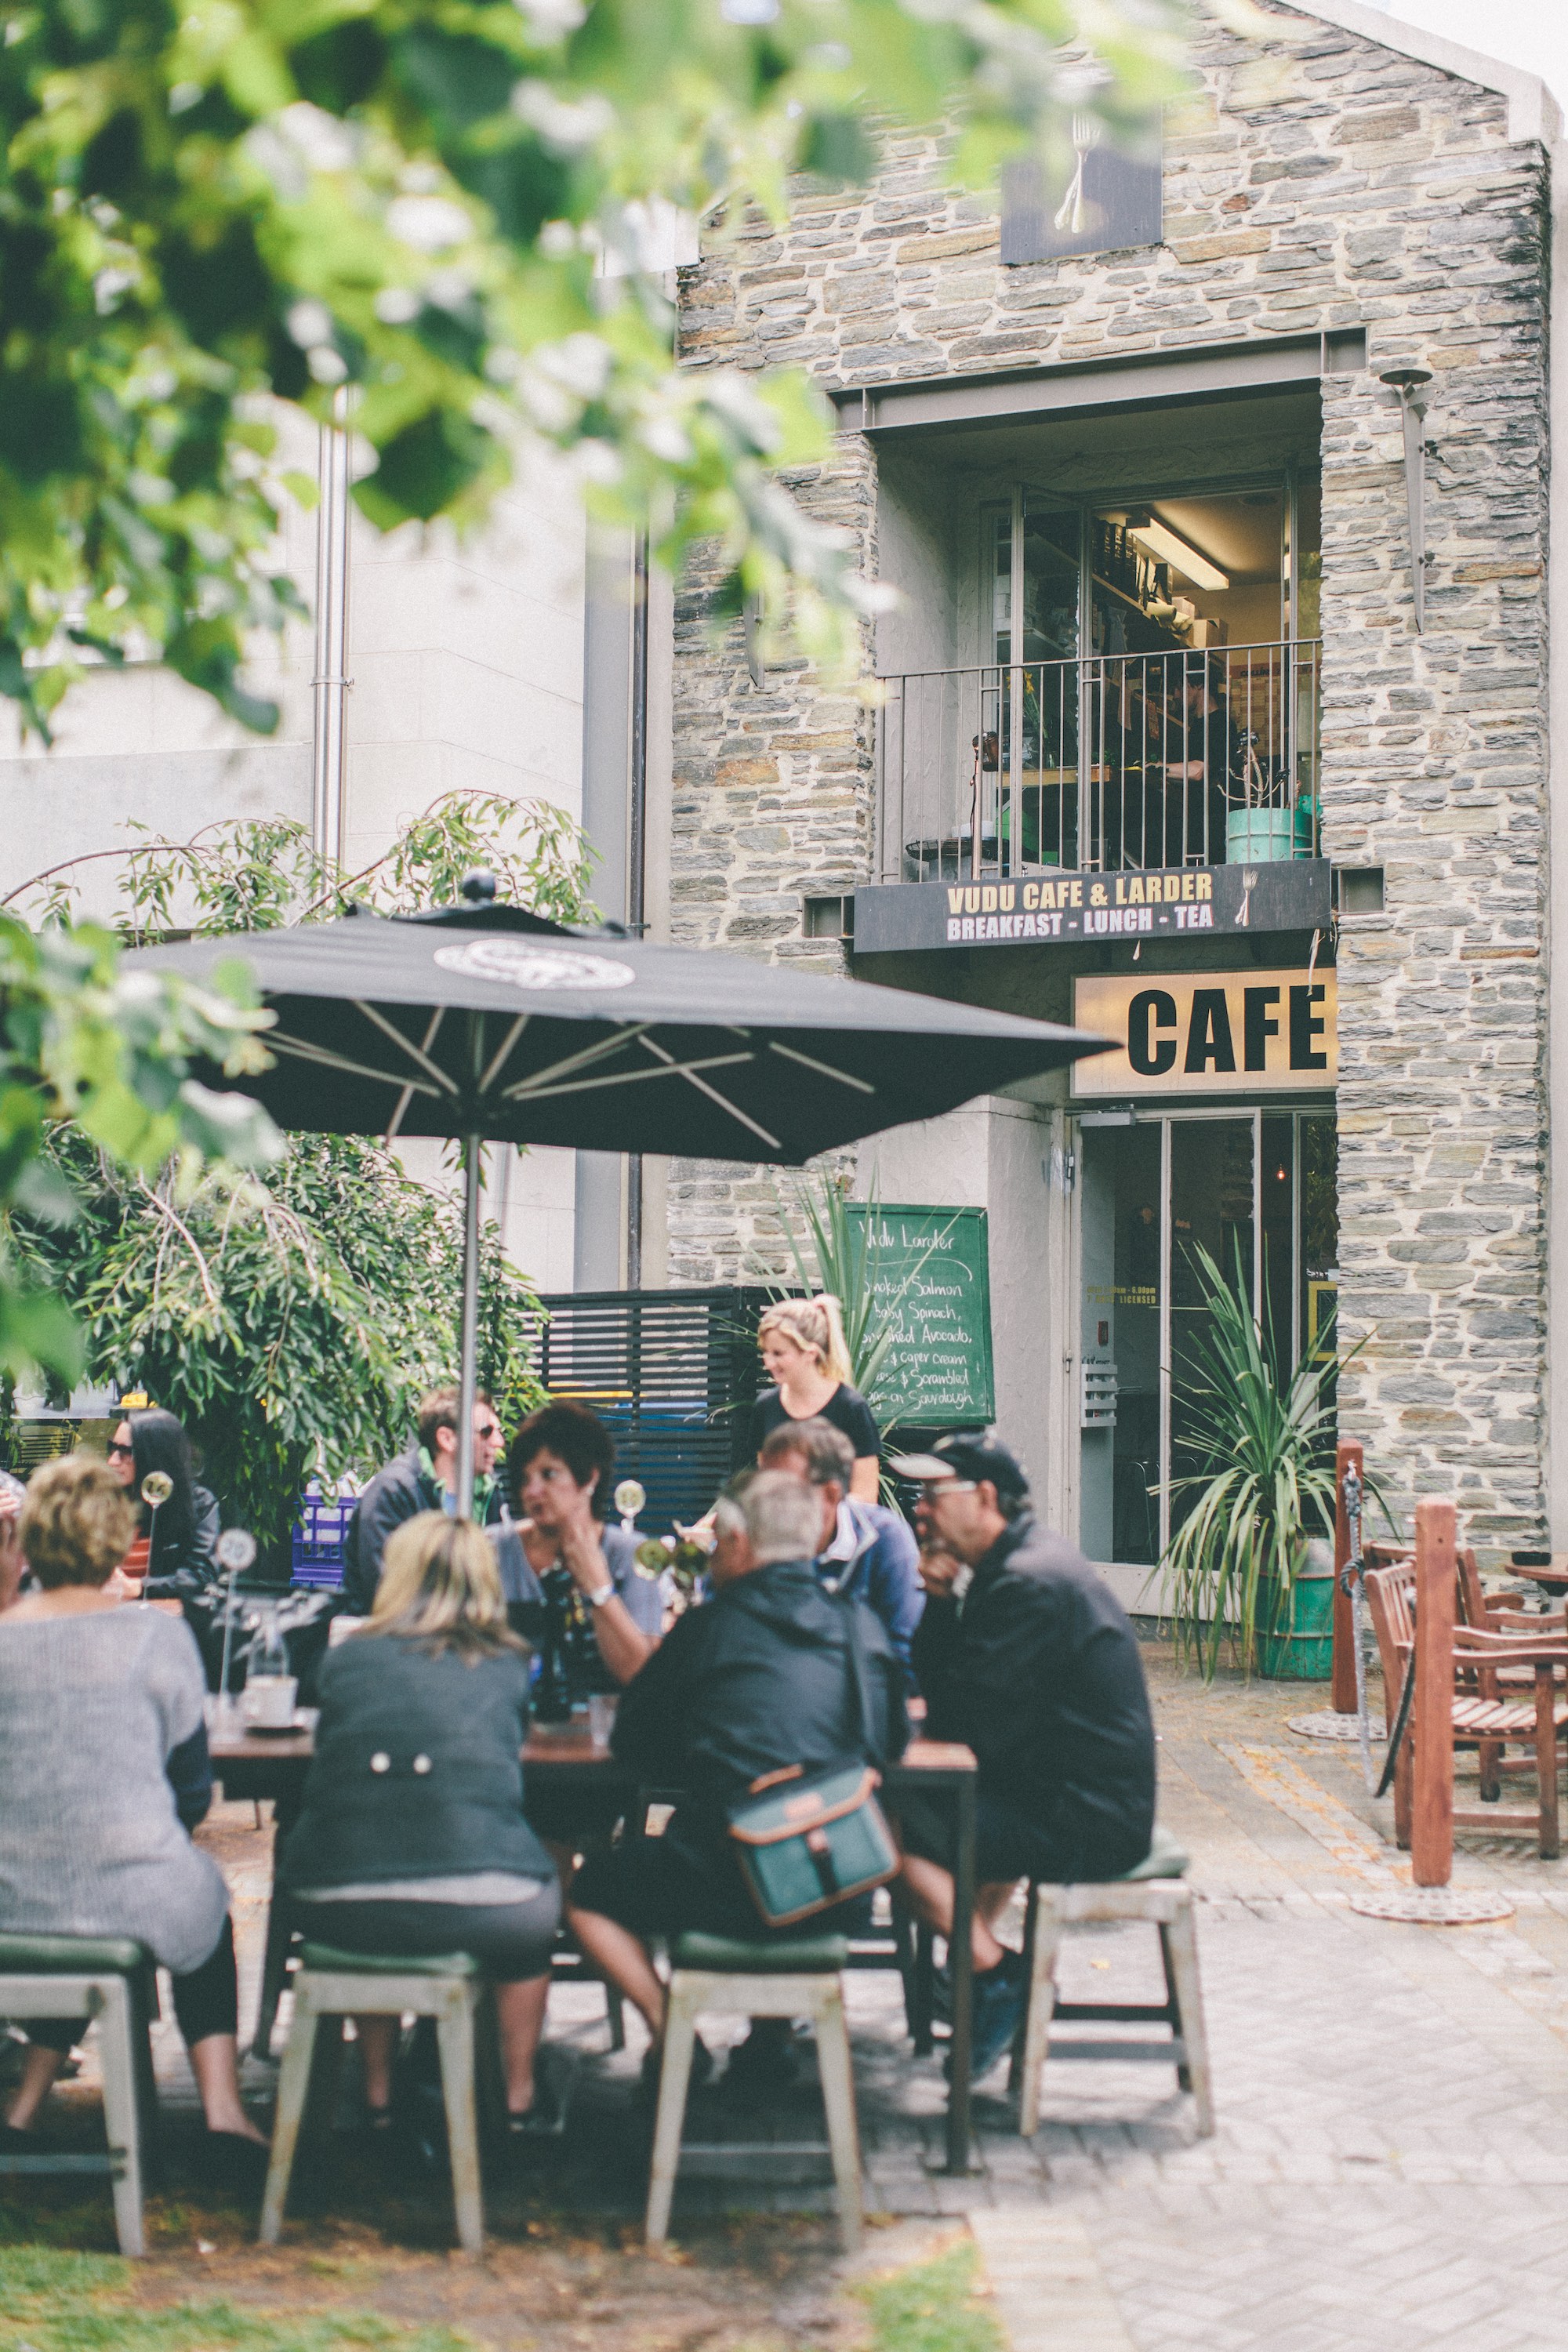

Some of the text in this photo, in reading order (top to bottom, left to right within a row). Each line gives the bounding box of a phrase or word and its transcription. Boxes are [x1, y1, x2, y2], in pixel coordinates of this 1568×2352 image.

[947, 873, 1213, 915] VUDU CAFE & LARDER
[947, 912, 1063, 942] BREAKFAST
[1083, 908, 1154, 935] LUNCH
[1174, 904, 1214, 930] TEA
[1127, 984, 1327, 1077] CAFE
[902, 1224, 955, 1250] Larder
[911, 1276, 963, 1298] Salmon
[1120, 1295, 1156, 1305] LICENSED
[909, 1367, 970, 1388] Scrambled
[908, 1387, 975, 1410] Sourdough
